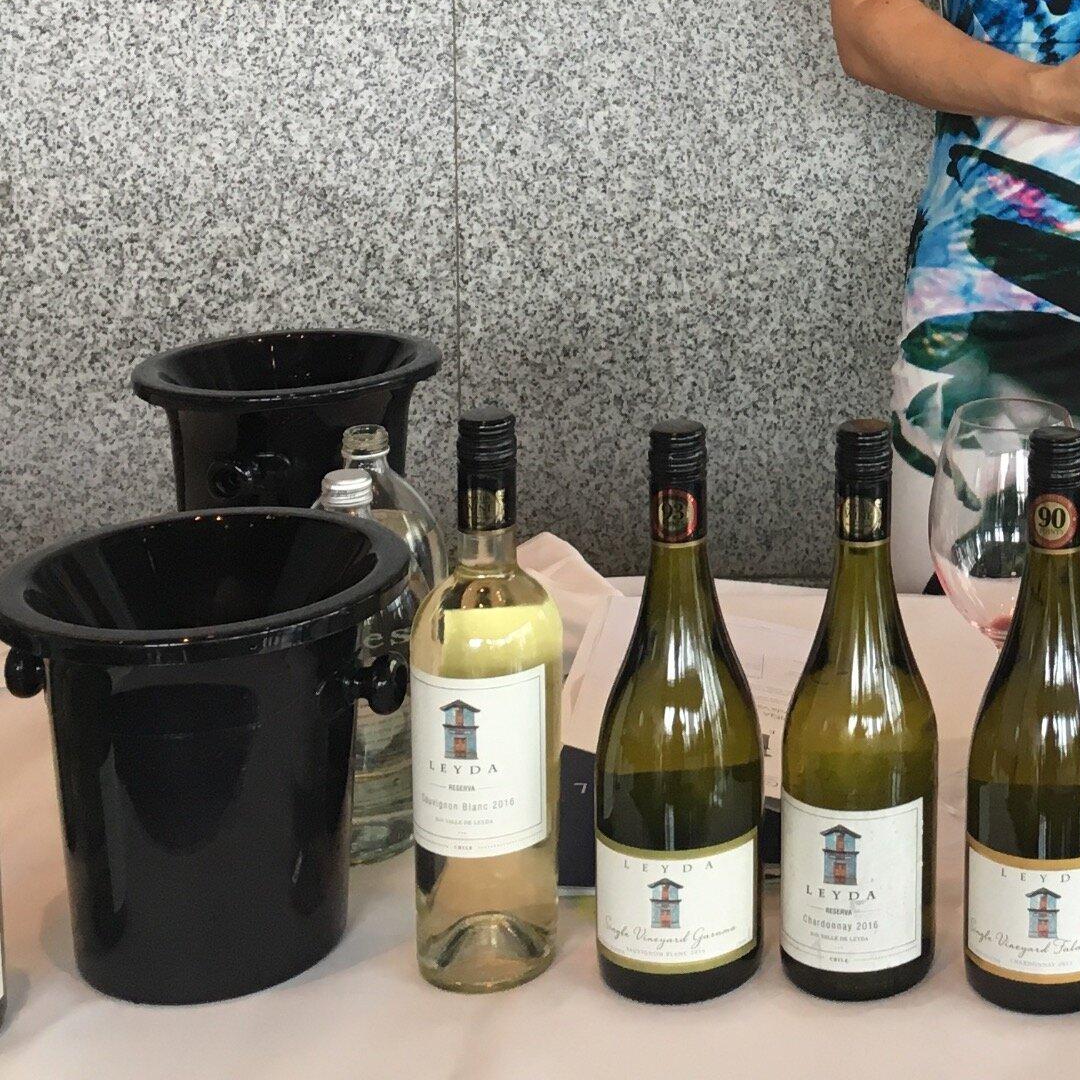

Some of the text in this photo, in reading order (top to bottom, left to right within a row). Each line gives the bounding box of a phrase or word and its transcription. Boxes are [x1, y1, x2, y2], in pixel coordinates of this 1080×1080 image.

[1038, 506, 1066, 529] 90
[428, 760, 499, 775] LEYDA
[461, 801, 489, 812] Blanc
[491, 797, 515, 810] 2016
[624, 859, 714, 874] LEYDA
[805, 884, 877, 901] LEYDA
[825, 907, 853, 916] RESERVA
[802, 913, 879, 932] Chardonnay 2016
[632, 925, 692, 951] Vineyard
[994, 931, 1051, 959] Vineyard
